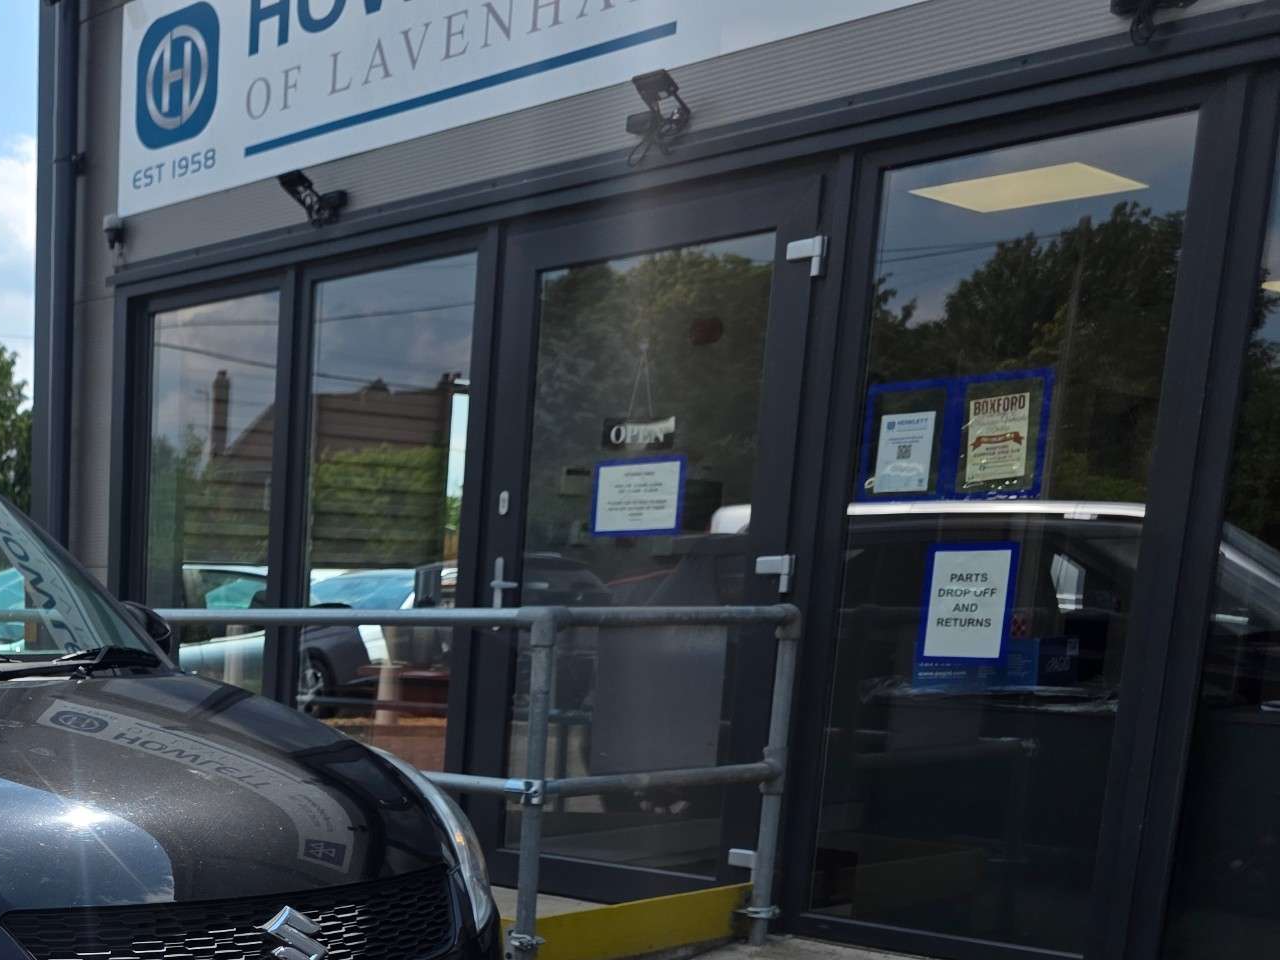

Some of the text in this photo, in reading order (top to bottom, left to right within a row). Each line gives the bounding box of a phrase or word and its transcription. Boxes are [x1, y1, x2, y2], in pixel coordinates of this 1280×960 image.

[245, 0, 630, 121] OF LAVENH
[132, 148, 217, 190] EST 1958
[973, 394, 1026, 417] BOXFORD
[950, 573, 988, 583] PARTS
[937, 588, 998, 598] DROP OFF
[952, 603, 979, 613] AND
[936, 617, 992, 628] RETURNS
